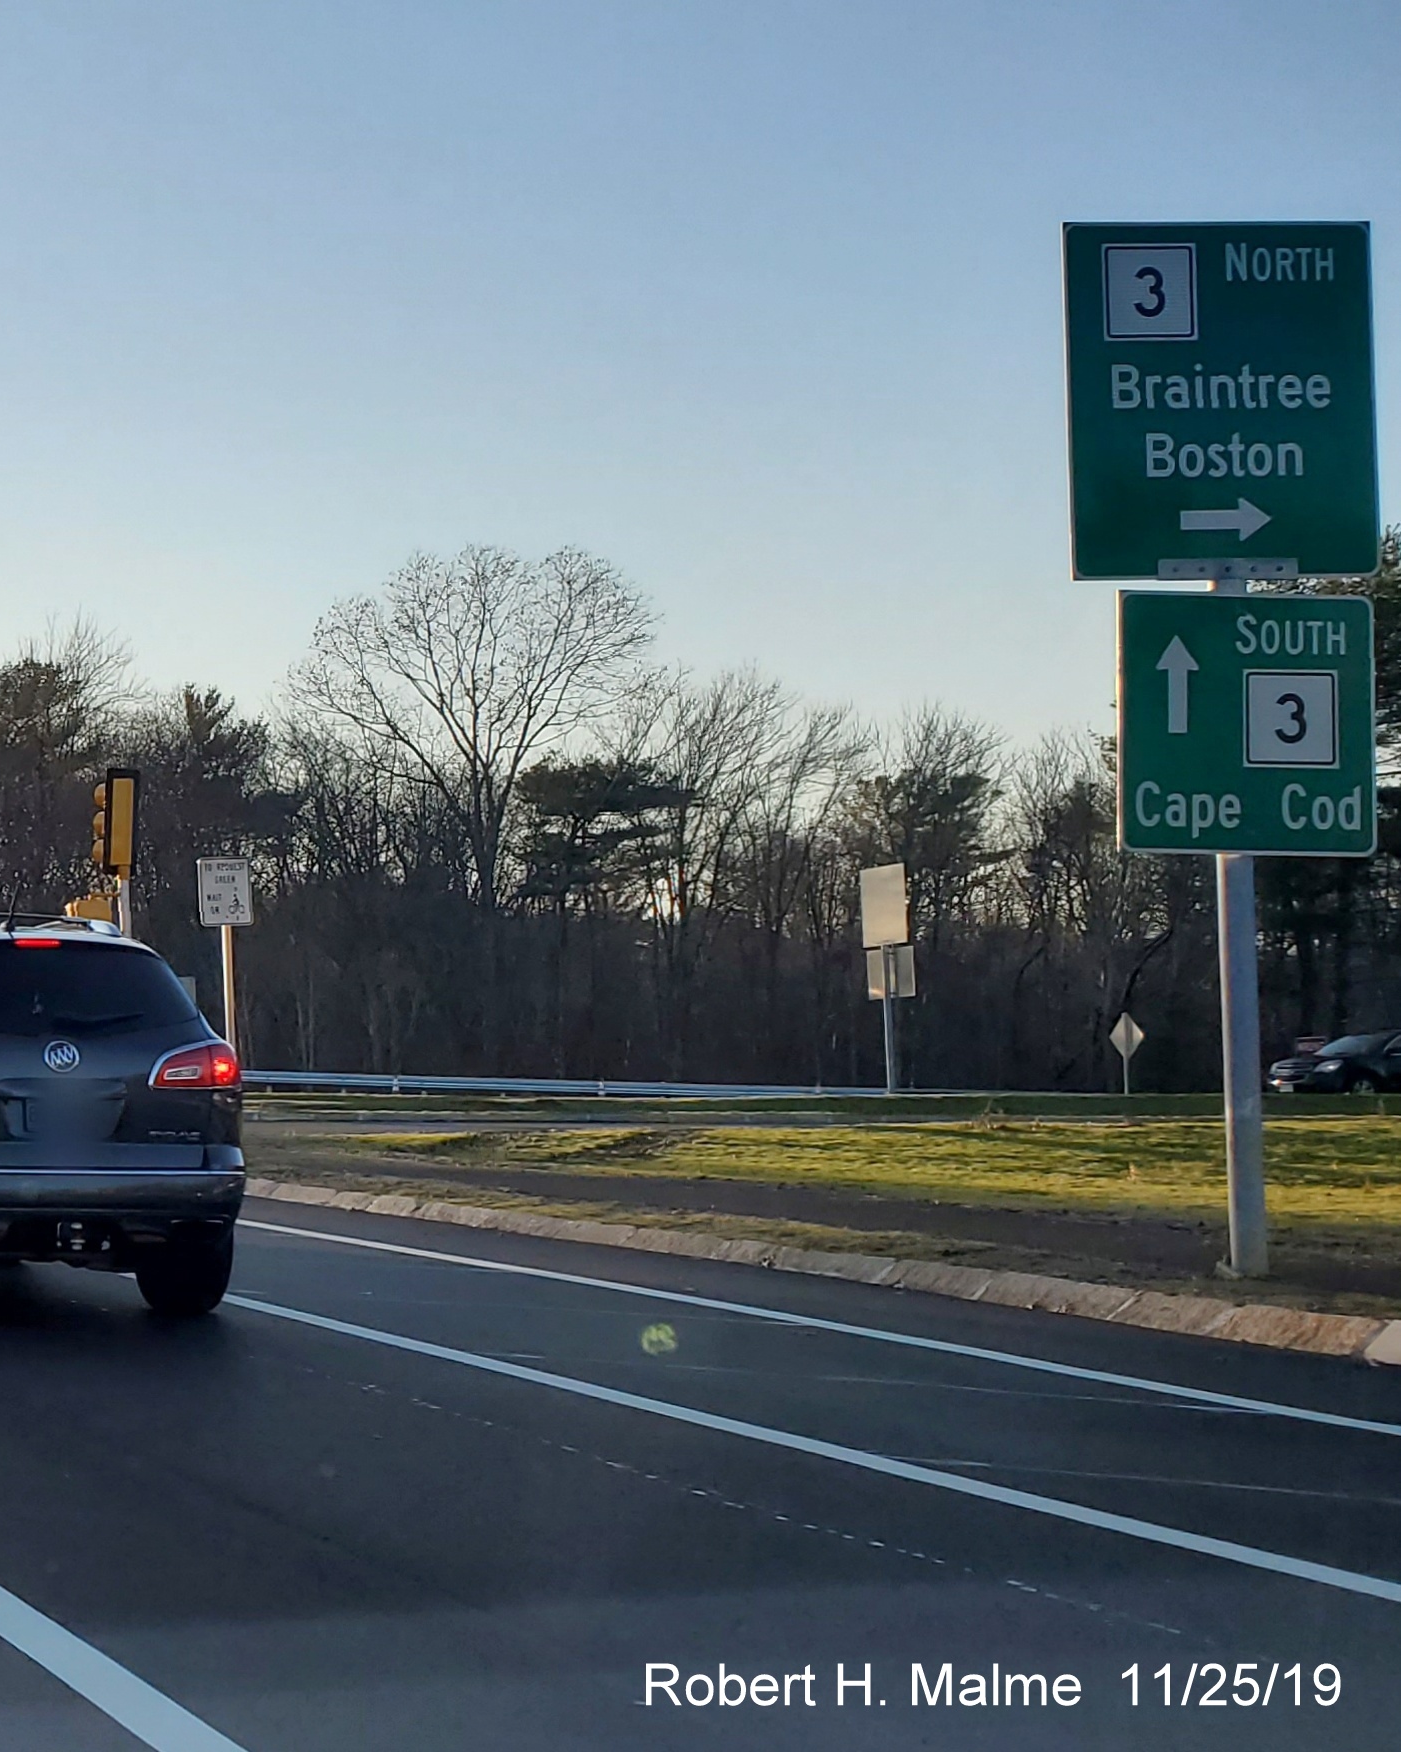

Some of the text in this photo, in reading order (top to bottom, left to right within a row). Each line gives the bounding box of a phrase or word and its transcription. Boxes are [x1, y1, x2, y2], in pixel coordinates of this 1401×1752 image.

[1224, 242, 1335, 282] NORTH
[1132, 265, 1167, 318] 3
[1110, 362, 1332, 410] Braintree
[1144, 431, 1305, 478] Boston
[1234, 613, 1347, 656] SOUTH
[1273, 692, 1308, 744] 3
[1134, 780, 1362, 840] Cape Cod
